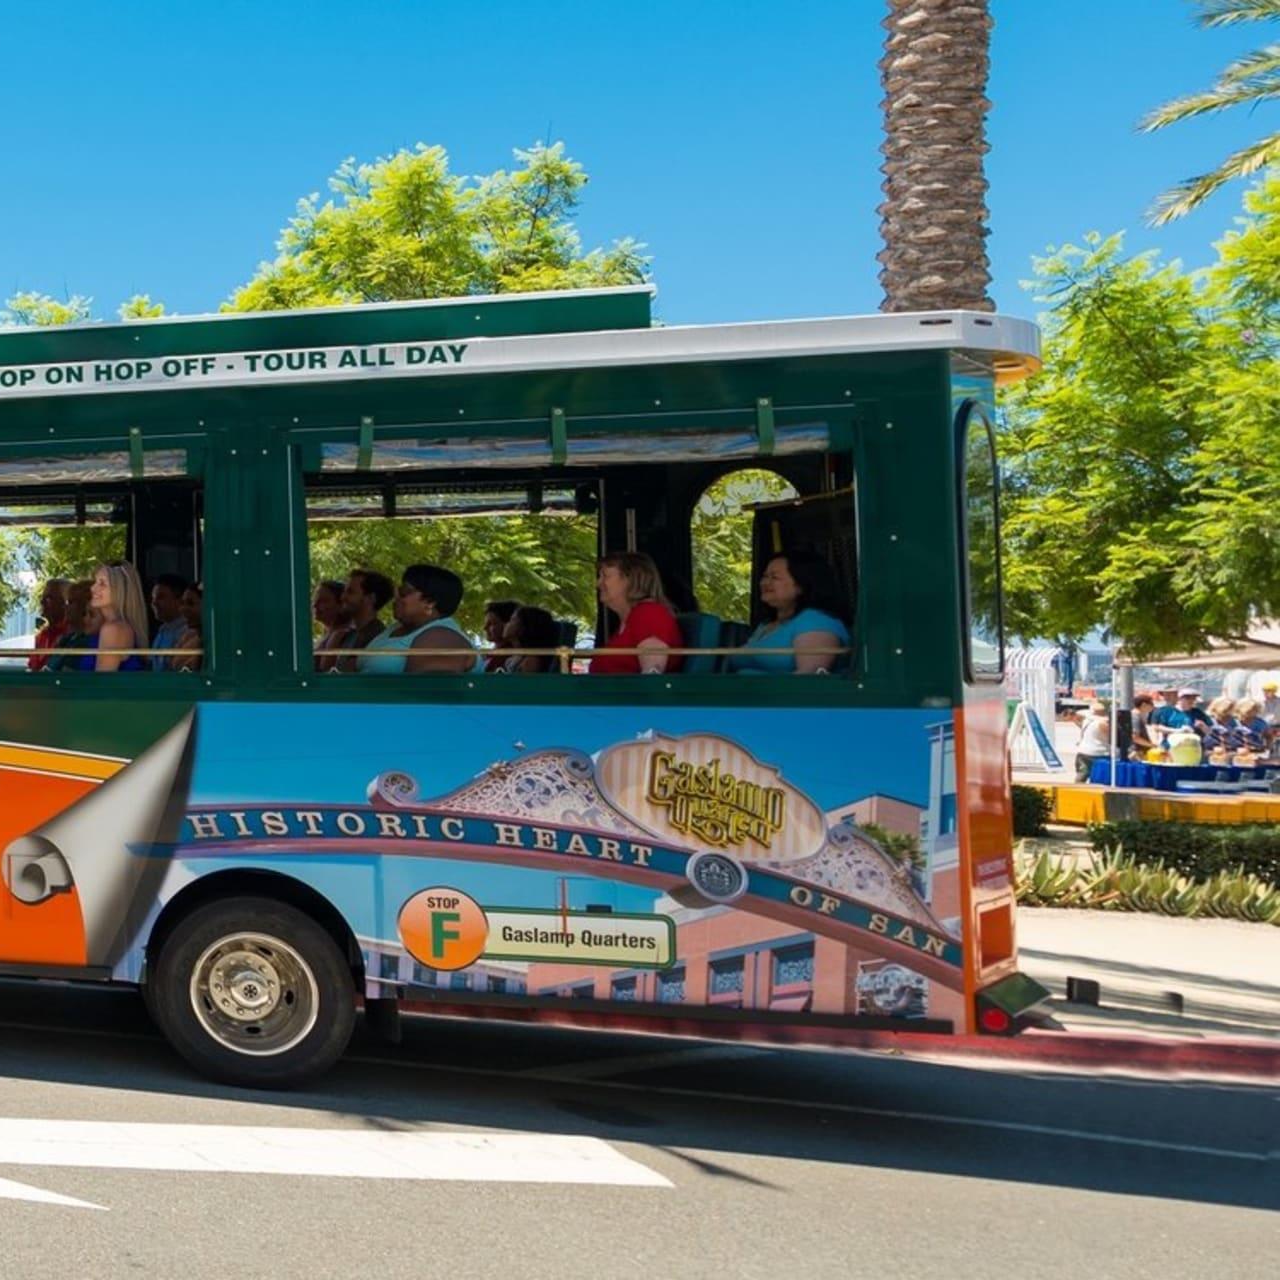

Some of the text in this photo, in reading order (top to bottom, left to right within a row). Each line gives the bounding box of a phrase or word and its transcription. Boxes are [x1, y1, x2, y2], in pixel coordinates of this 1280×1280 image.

[44, 365, 85, 386] ON
[93, 361, 153, 382] HOP
[161, 357, 217, 379] OFF
[244, 350, 328, 374] TOUR
[337, 346, 396, 369] ALL
[404, 343, 470, 365] DAY
[646, 750, 787, 833] Gaslamp
[184, 811, 948, 960] HISTORIC HEART OF SAN
[426, 896, 460, 910] STOP
[430, 912, 461, 959] F
[501, 925, 657, 951] Gaslamp Quarters
